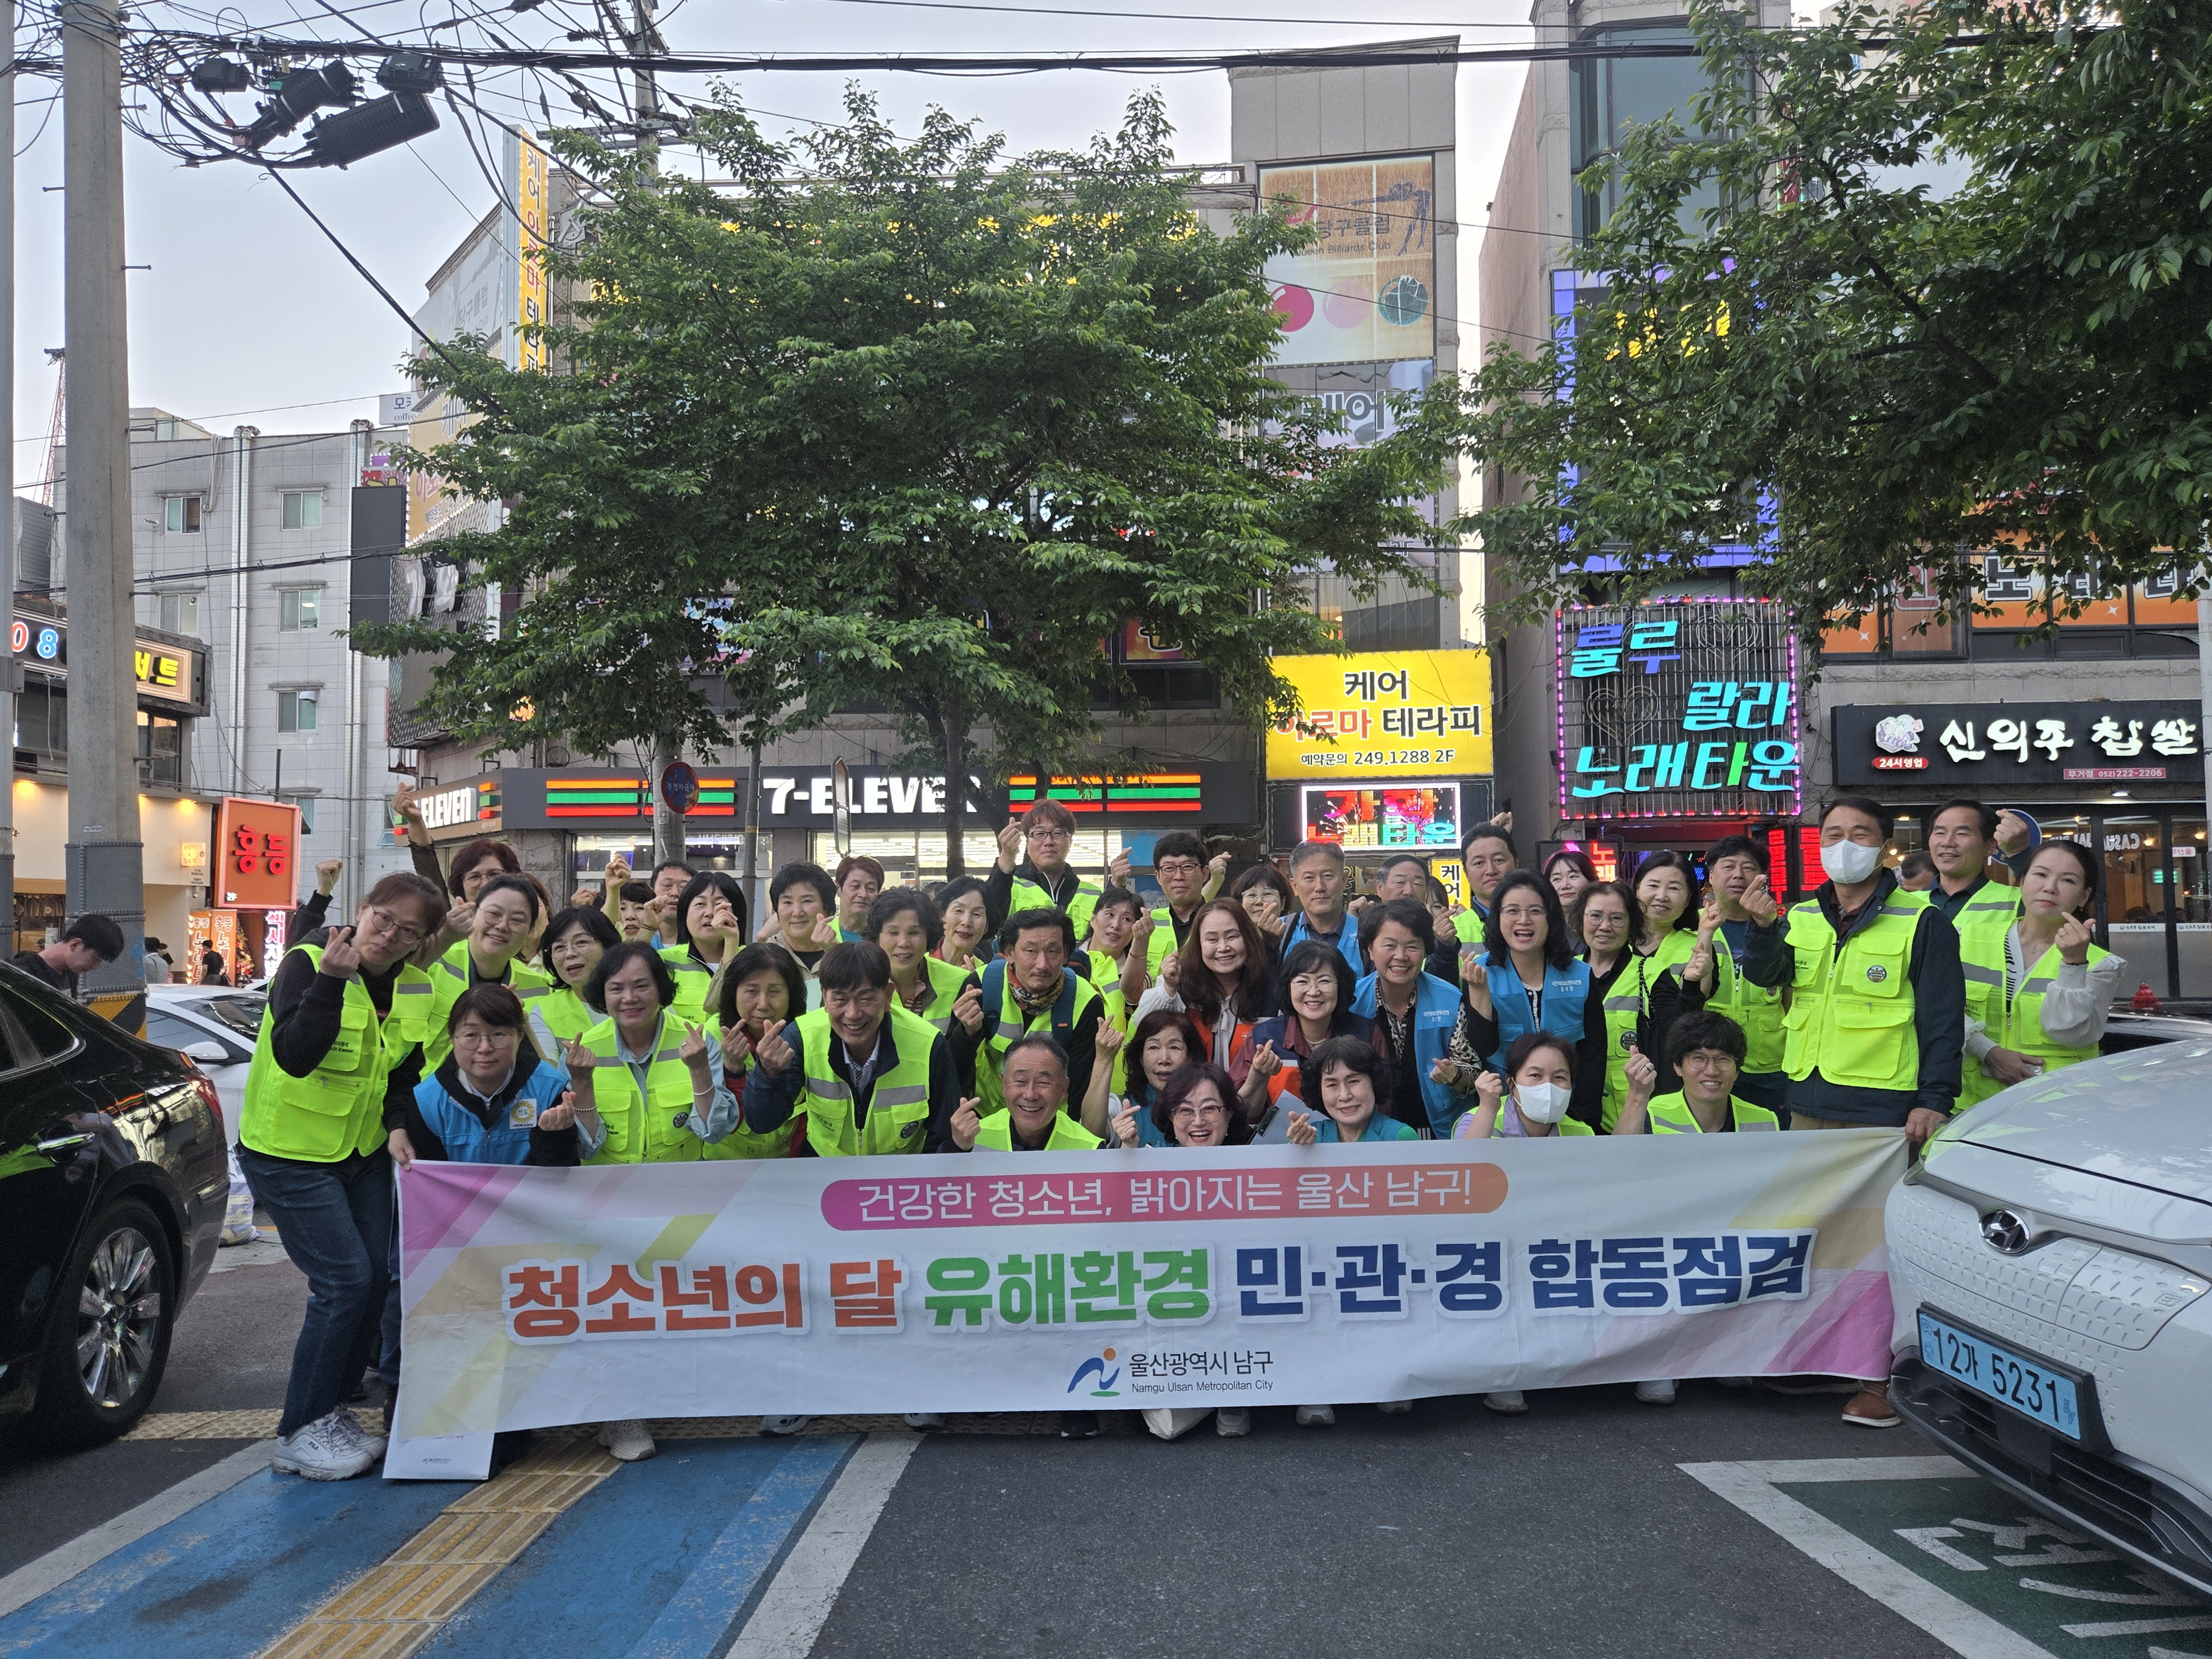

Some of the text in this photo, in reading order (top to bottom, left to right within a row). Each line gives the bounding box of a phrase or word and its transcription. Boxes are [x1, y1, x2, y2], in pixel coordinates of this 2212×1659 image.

[527, 146, 540, 211] 케어
[1328, 243, 1365, 254] Billiards
[1368, 241, 1391, 251] Club
[1569, 620, 1681, 679] 룰루
[1344, 670, 1408, 701] 케어
[1682, 681, 1792, 731] 랄라
[1382, 705, 1482, 738] 테라피
[1939, 716, 2198, 763] 신의주 찹쌀
[1301, 749, 1455, 766] 예약문의 249.1288 2F
[1572, 739, 1800, 799] 노래타운
[763, 778, 981, 814] 7-ELEVE
[233, 824, 290, 875] 홍등
[858, 1170, 1472, 1222] 건강한 청소년, 밝아지는 울산 남구!
[508, 1263, 803, 1337] 청소년의
[832, 1260, 901, 1328] 달
[925, 1250, 1210, 1326] 유해환경
[1528, 1235, 1812, 1310] 합동점검
[1129, 1350, 1274, 1378] 울산광역시 남구
[1131, 1380, 1274, 1394] Namgu Ulsan Metropolitan City
[1932, 1326, 2060, 1423] 12가 5231
